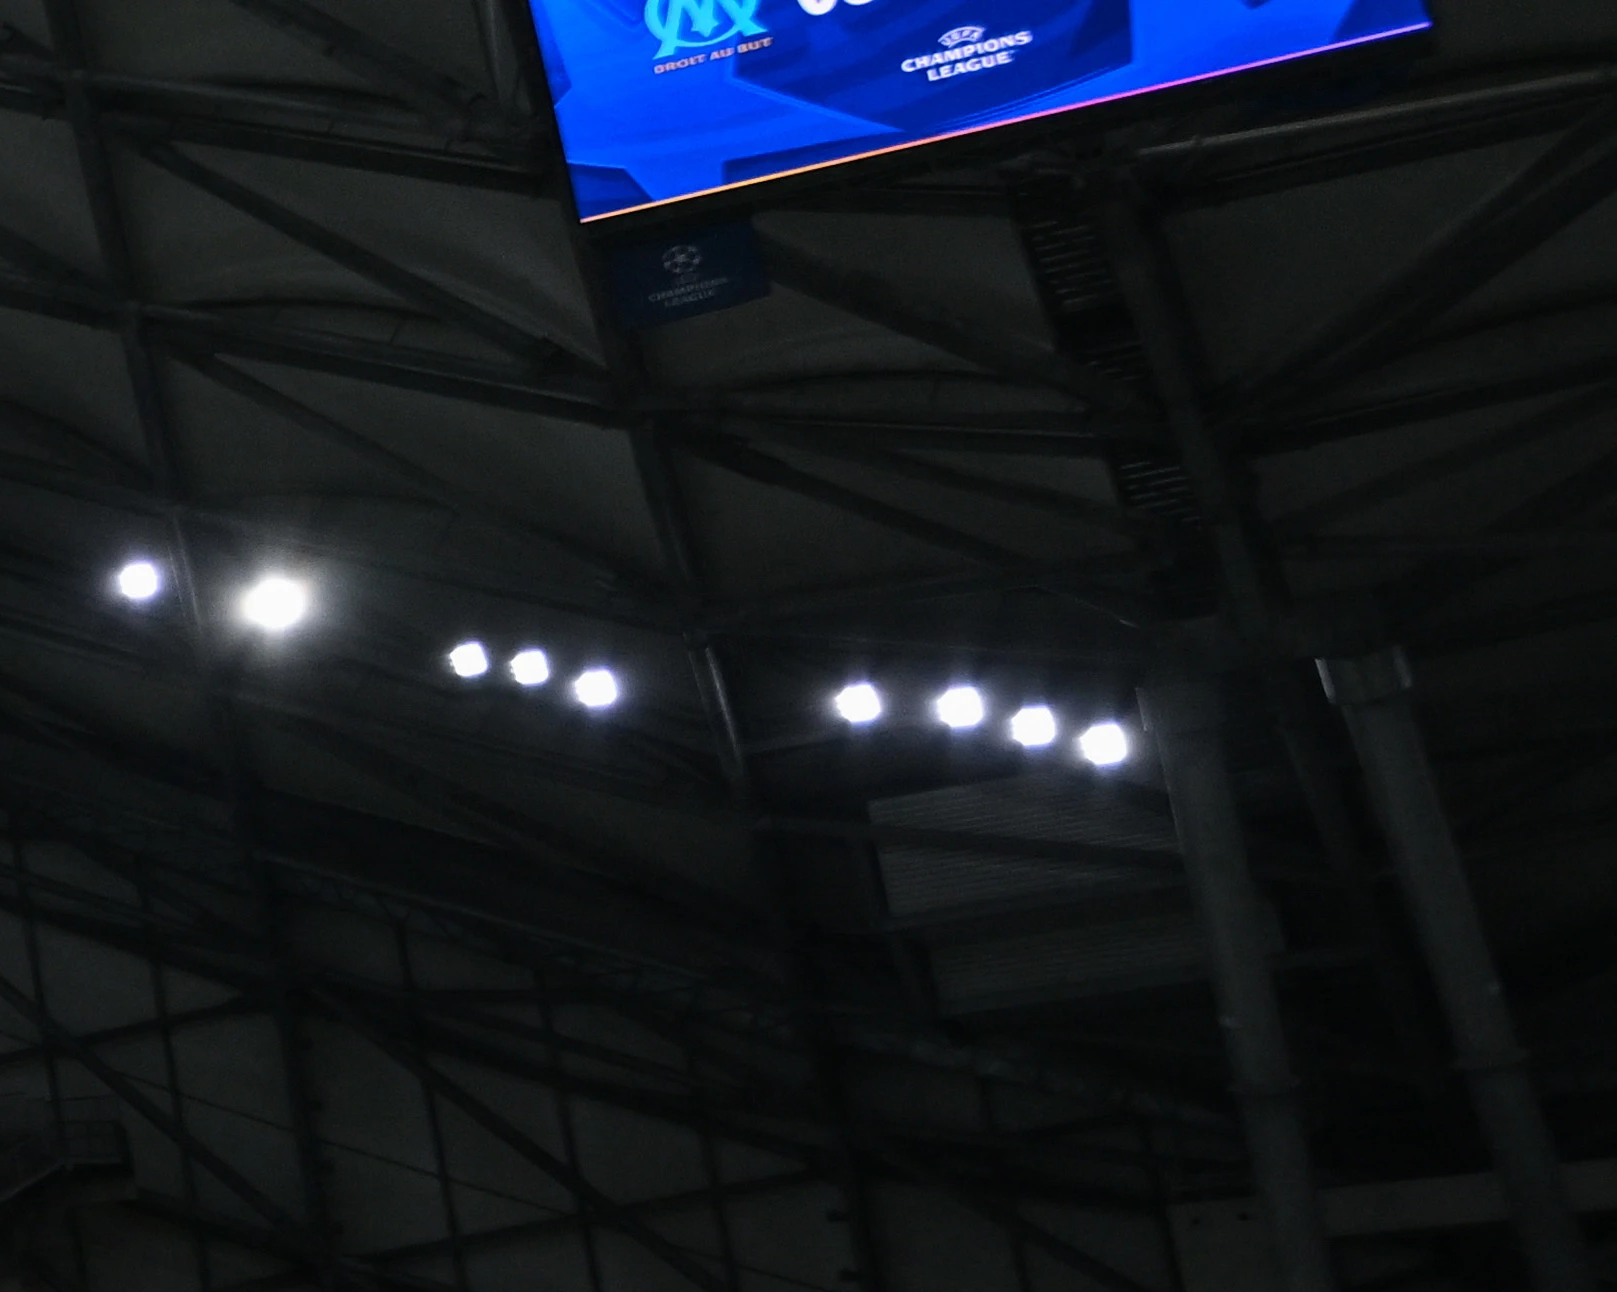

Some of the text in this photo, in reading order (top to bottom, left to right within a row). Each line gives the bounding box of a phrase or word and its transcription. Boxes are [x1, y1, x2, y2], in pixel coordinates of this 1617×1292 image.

[653, 37, 773, 75] DROIT AU BUT
[900, 30, 1034, 73] CHAMPIONS
[926, 50, 1016, 82] LEAGUE
